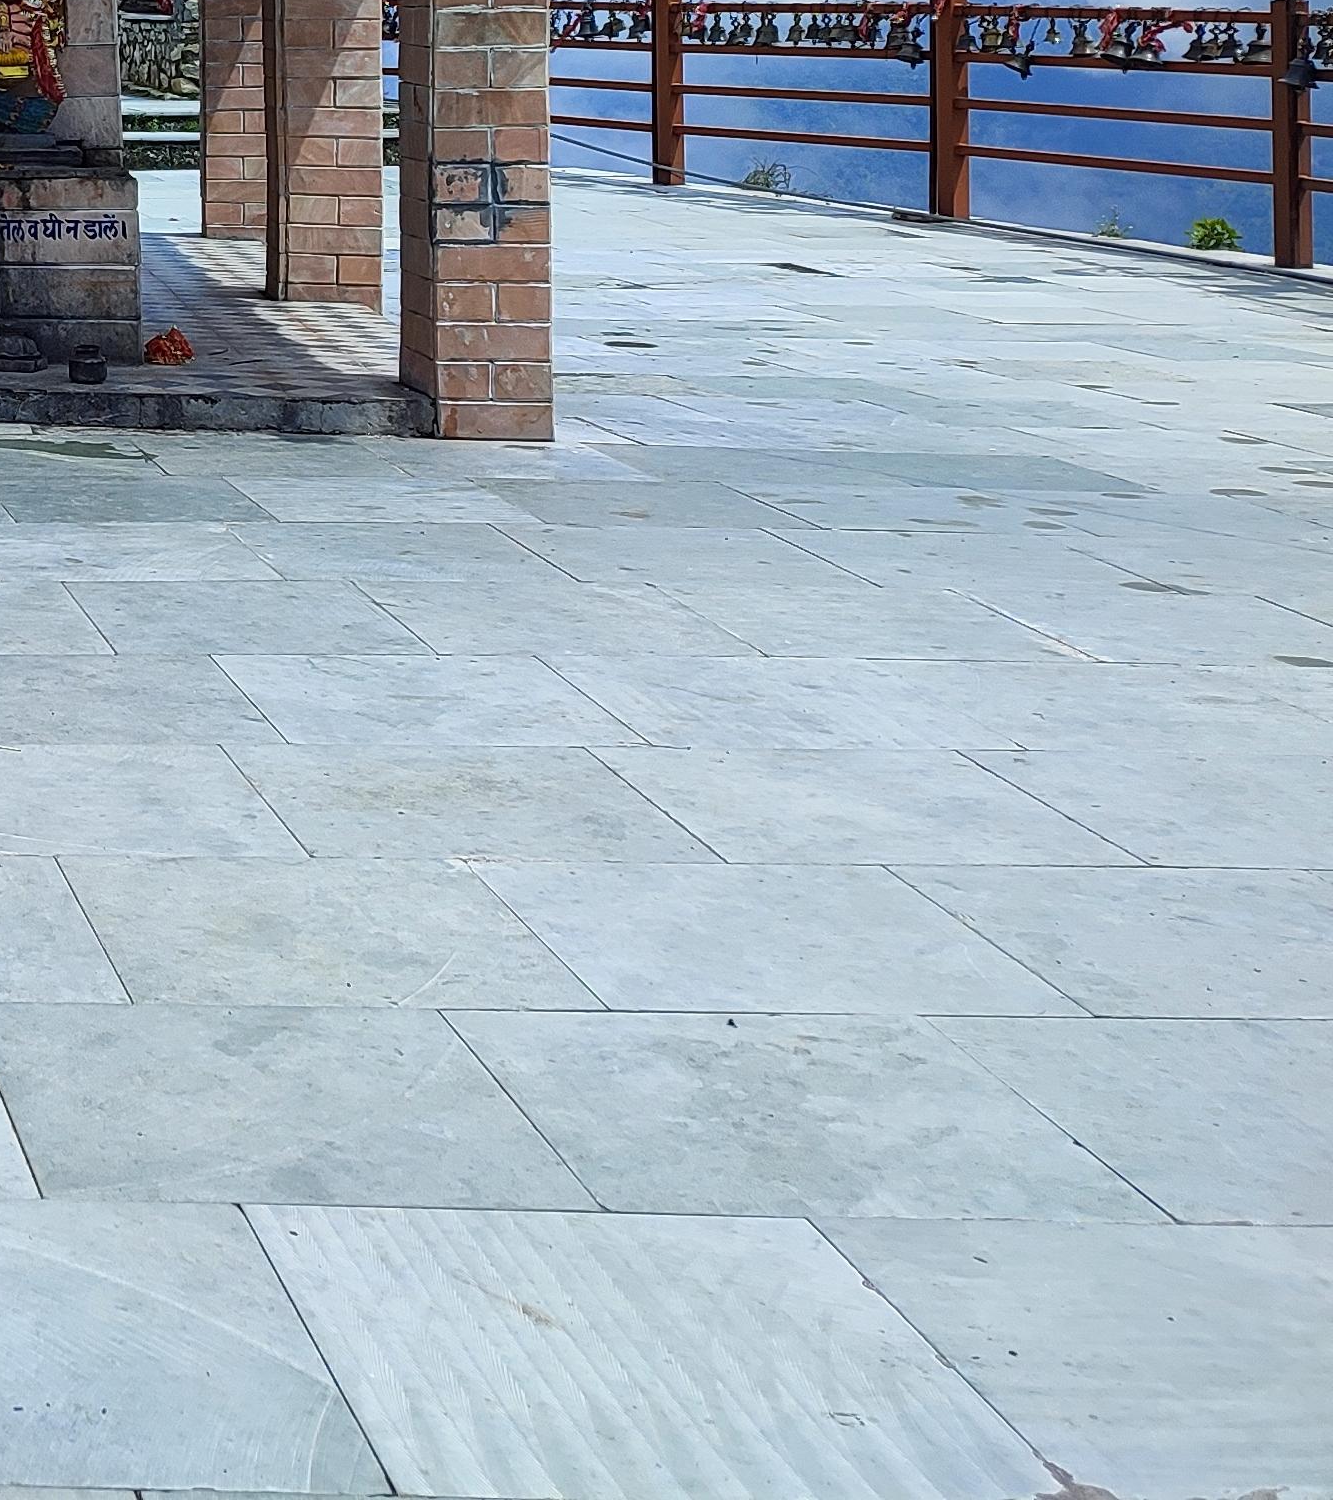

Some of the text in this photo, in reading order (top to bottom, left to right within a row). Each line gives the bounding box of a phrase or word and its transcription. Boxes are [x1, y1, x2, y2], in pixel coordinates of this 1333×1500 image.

[24, 219, 40, 241] व
[39, 213, 65, 241] घी
[65, 219, 83, 241] न
